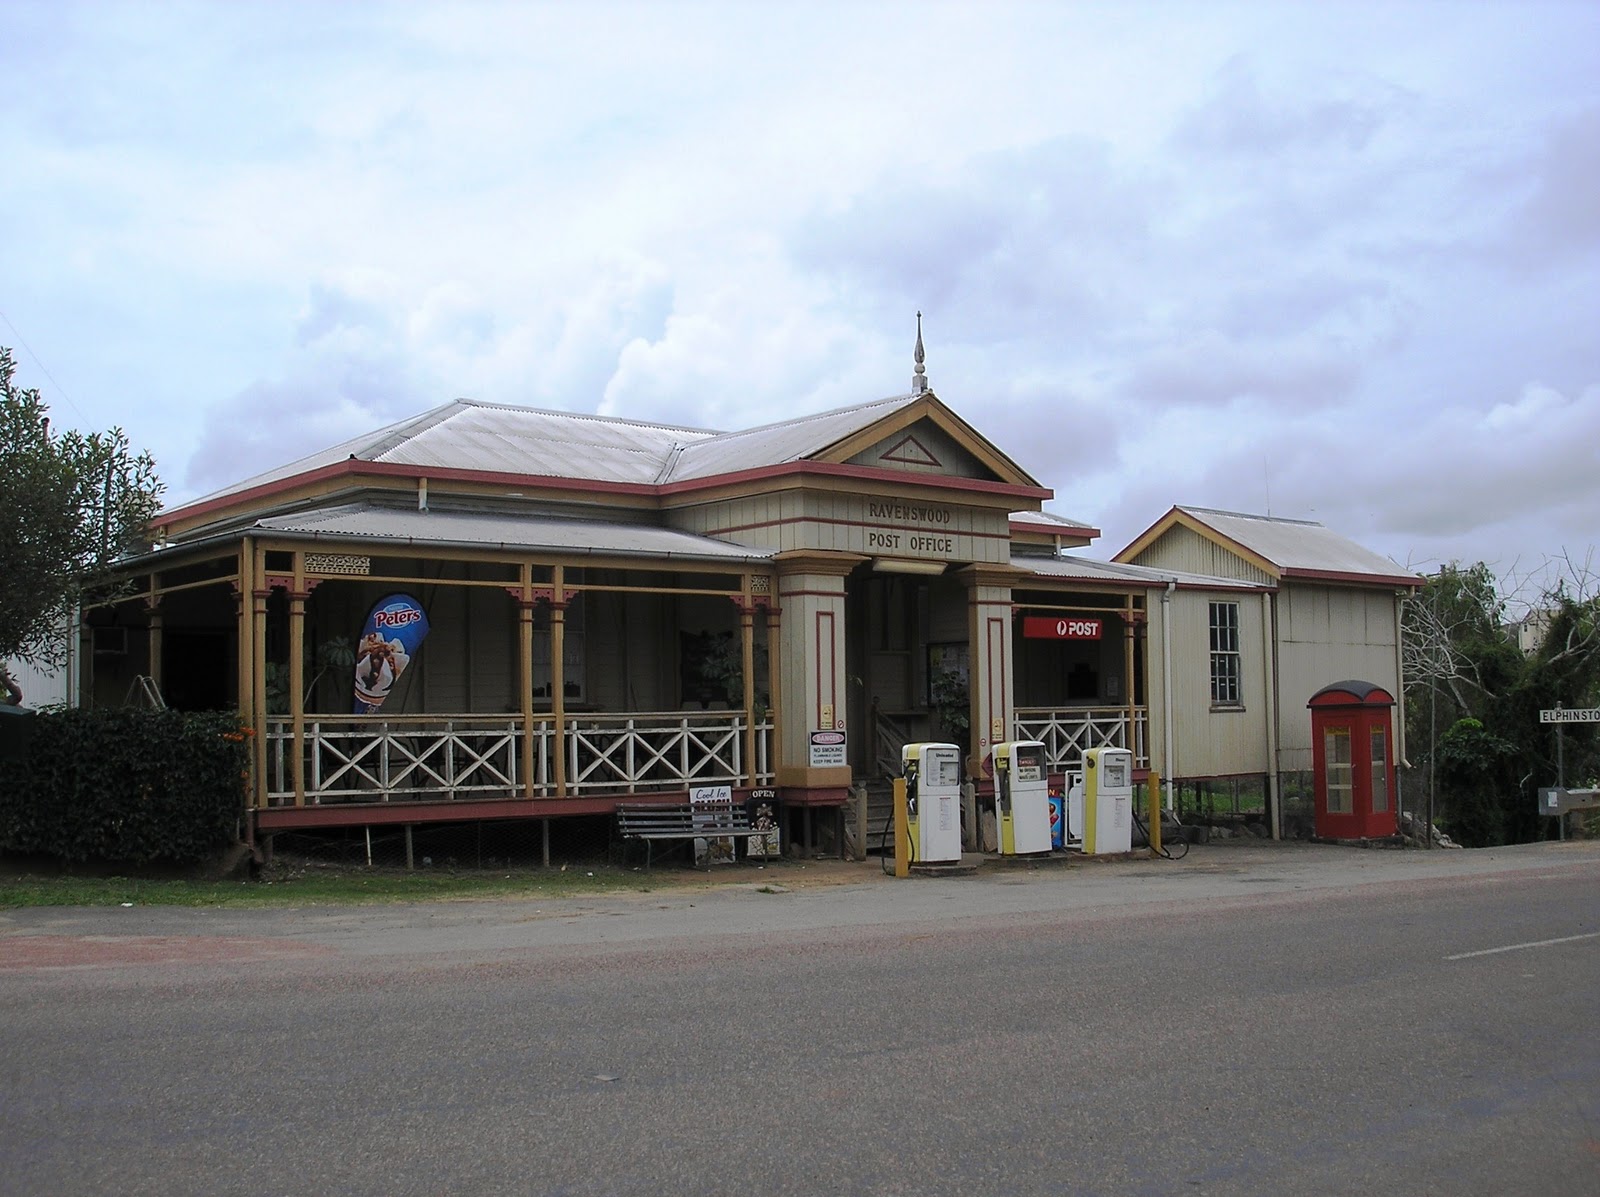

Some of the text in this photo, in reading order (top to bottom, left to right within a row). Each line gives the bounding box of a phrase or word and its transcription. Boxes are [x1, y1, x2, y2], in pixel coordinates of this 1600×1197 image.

[869, 503, 950, 524] RAVENSWOOD
[869, 533, 952, 552] POST OFFICE
[375, 609, 421, 628] Peters
[1068, 622, 1098, 636] POST
[1543, 711, 1600, 721] ELPHINSTO
[696, 788, 728, 799] Cool Ice
[752, 790, 775, 798] OPEN
